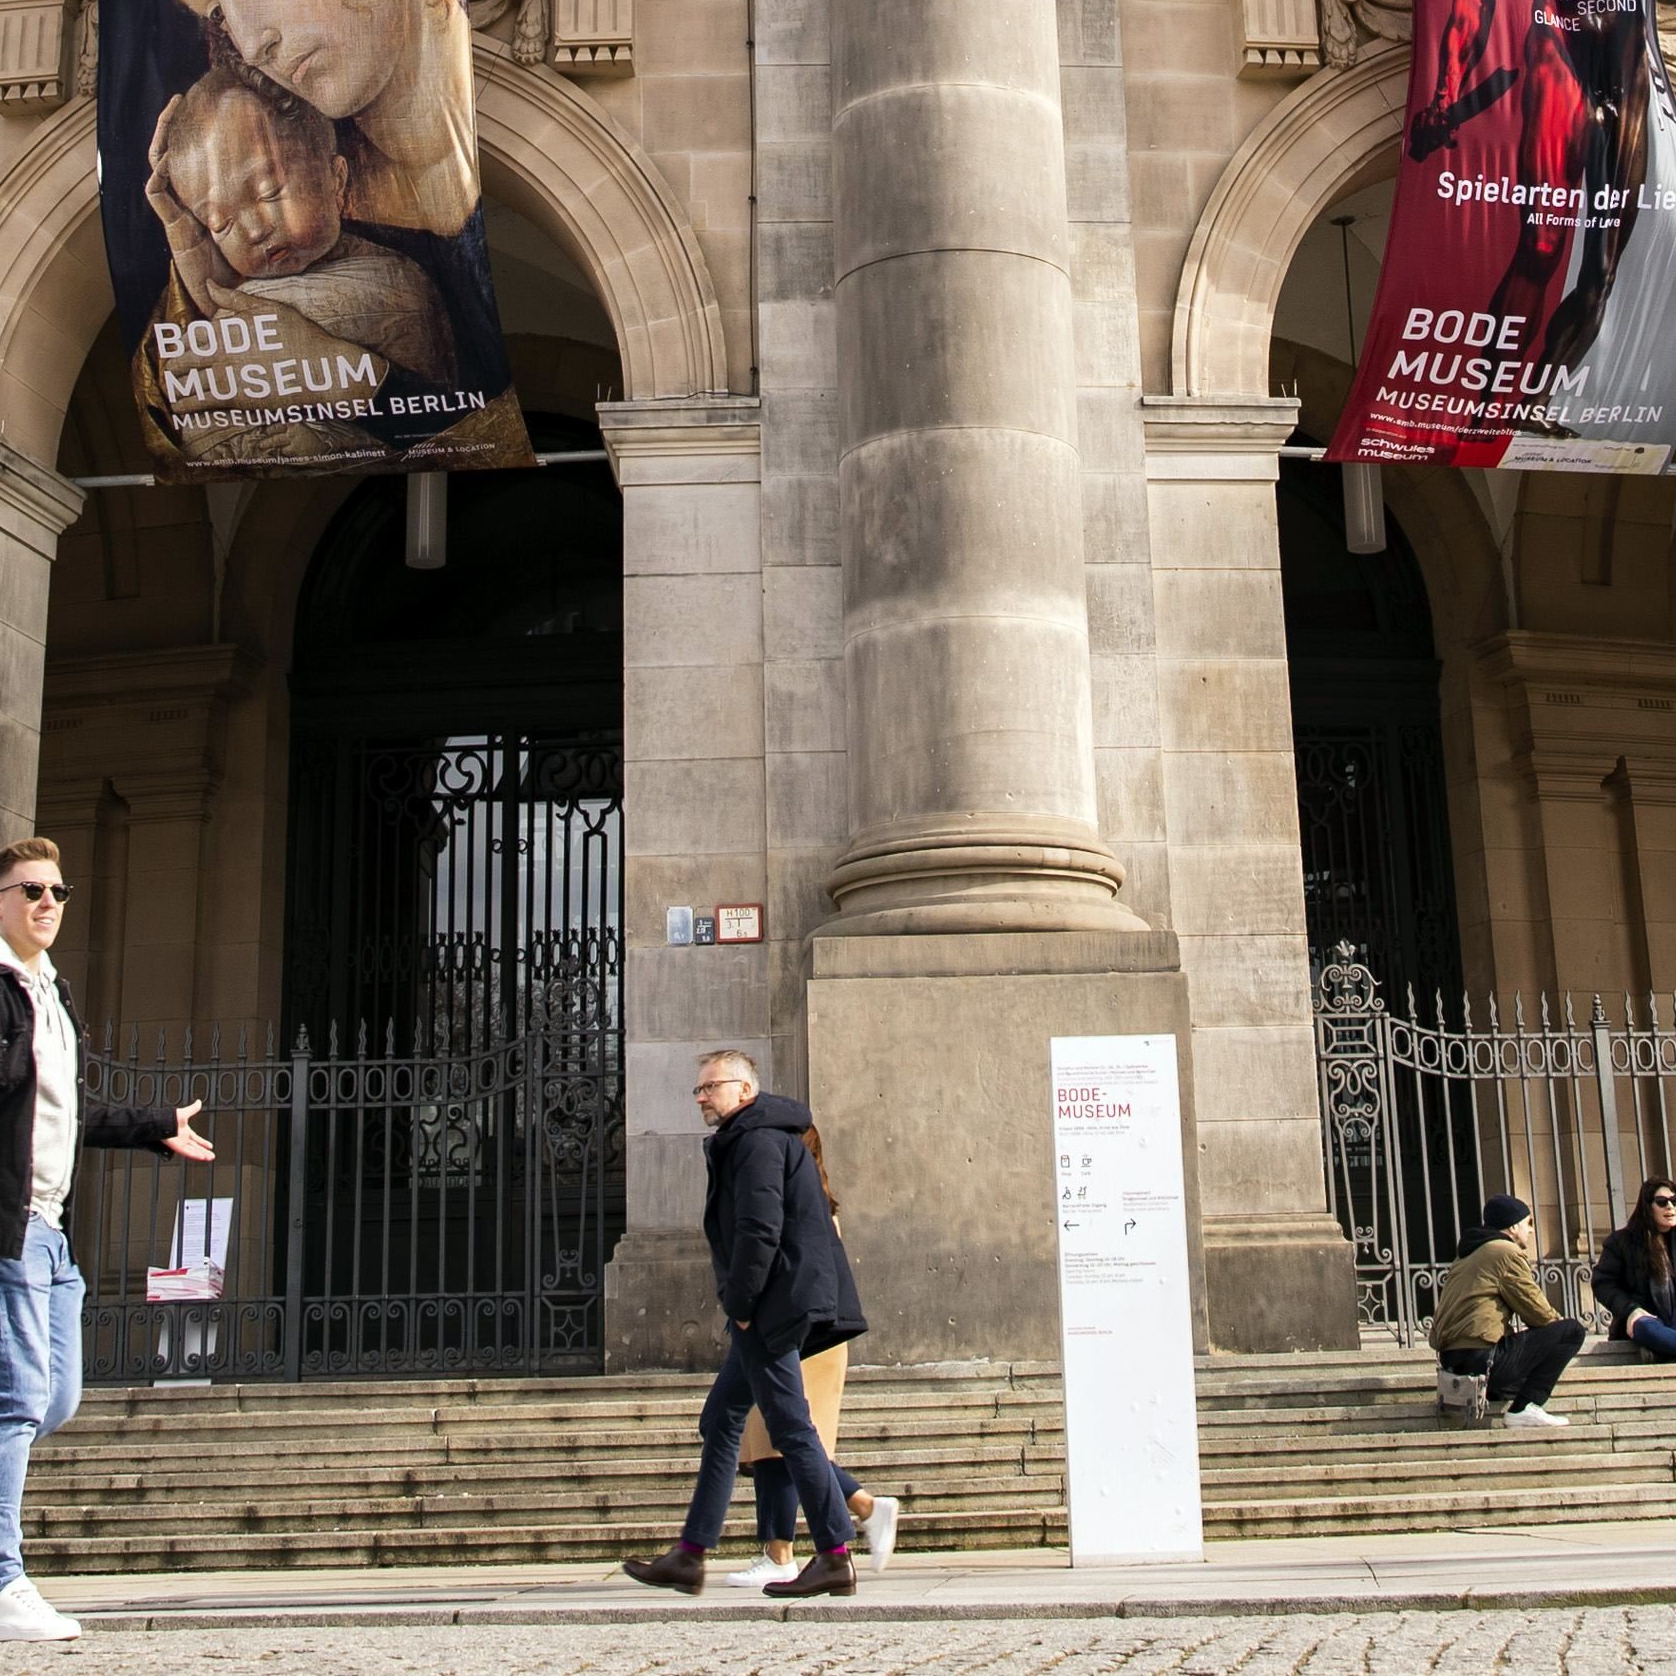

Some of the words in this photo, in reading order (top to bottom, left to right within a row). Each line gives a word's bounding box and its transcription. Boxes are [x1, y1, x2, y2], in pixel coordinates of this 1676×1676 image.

[1534, 9, 1581, 32] GLANCE
[1437, 171, 1585, 209] Spielarten
[1593, 182, 1630, 211] der
[1526, 213, 1543, 226] All
[1545, 214, 1581, 228] Forms
[1584, 216, 1597, 229] of
[154, 313, 284, 359] BODE
[1401, 308, 1527, 351] BODE
[163, 353, 378, 404] MUSEUM
[1387, 349, 1591, 398] MUSEUM
[171, 398, 383, 430] MUSEUMSINSEL
[389, 390, 486, 415] BERLIN
[1375, 386, 1571, 423] MUSEUMSINSEL
[1579, 405, 1663, 424] BERLIN
[455, 443, 496, 453] LOCATION
[1357, 448, 1428, 461] museum
[1360, 437, 1436, 454] schwules
[186, 449, 387, 467] www.smb.museum/james-simon-kabinett
[1057, 1087, 1107, 1103] BODE-
[1058, 1103, 1132, 1119] MUSEUM
